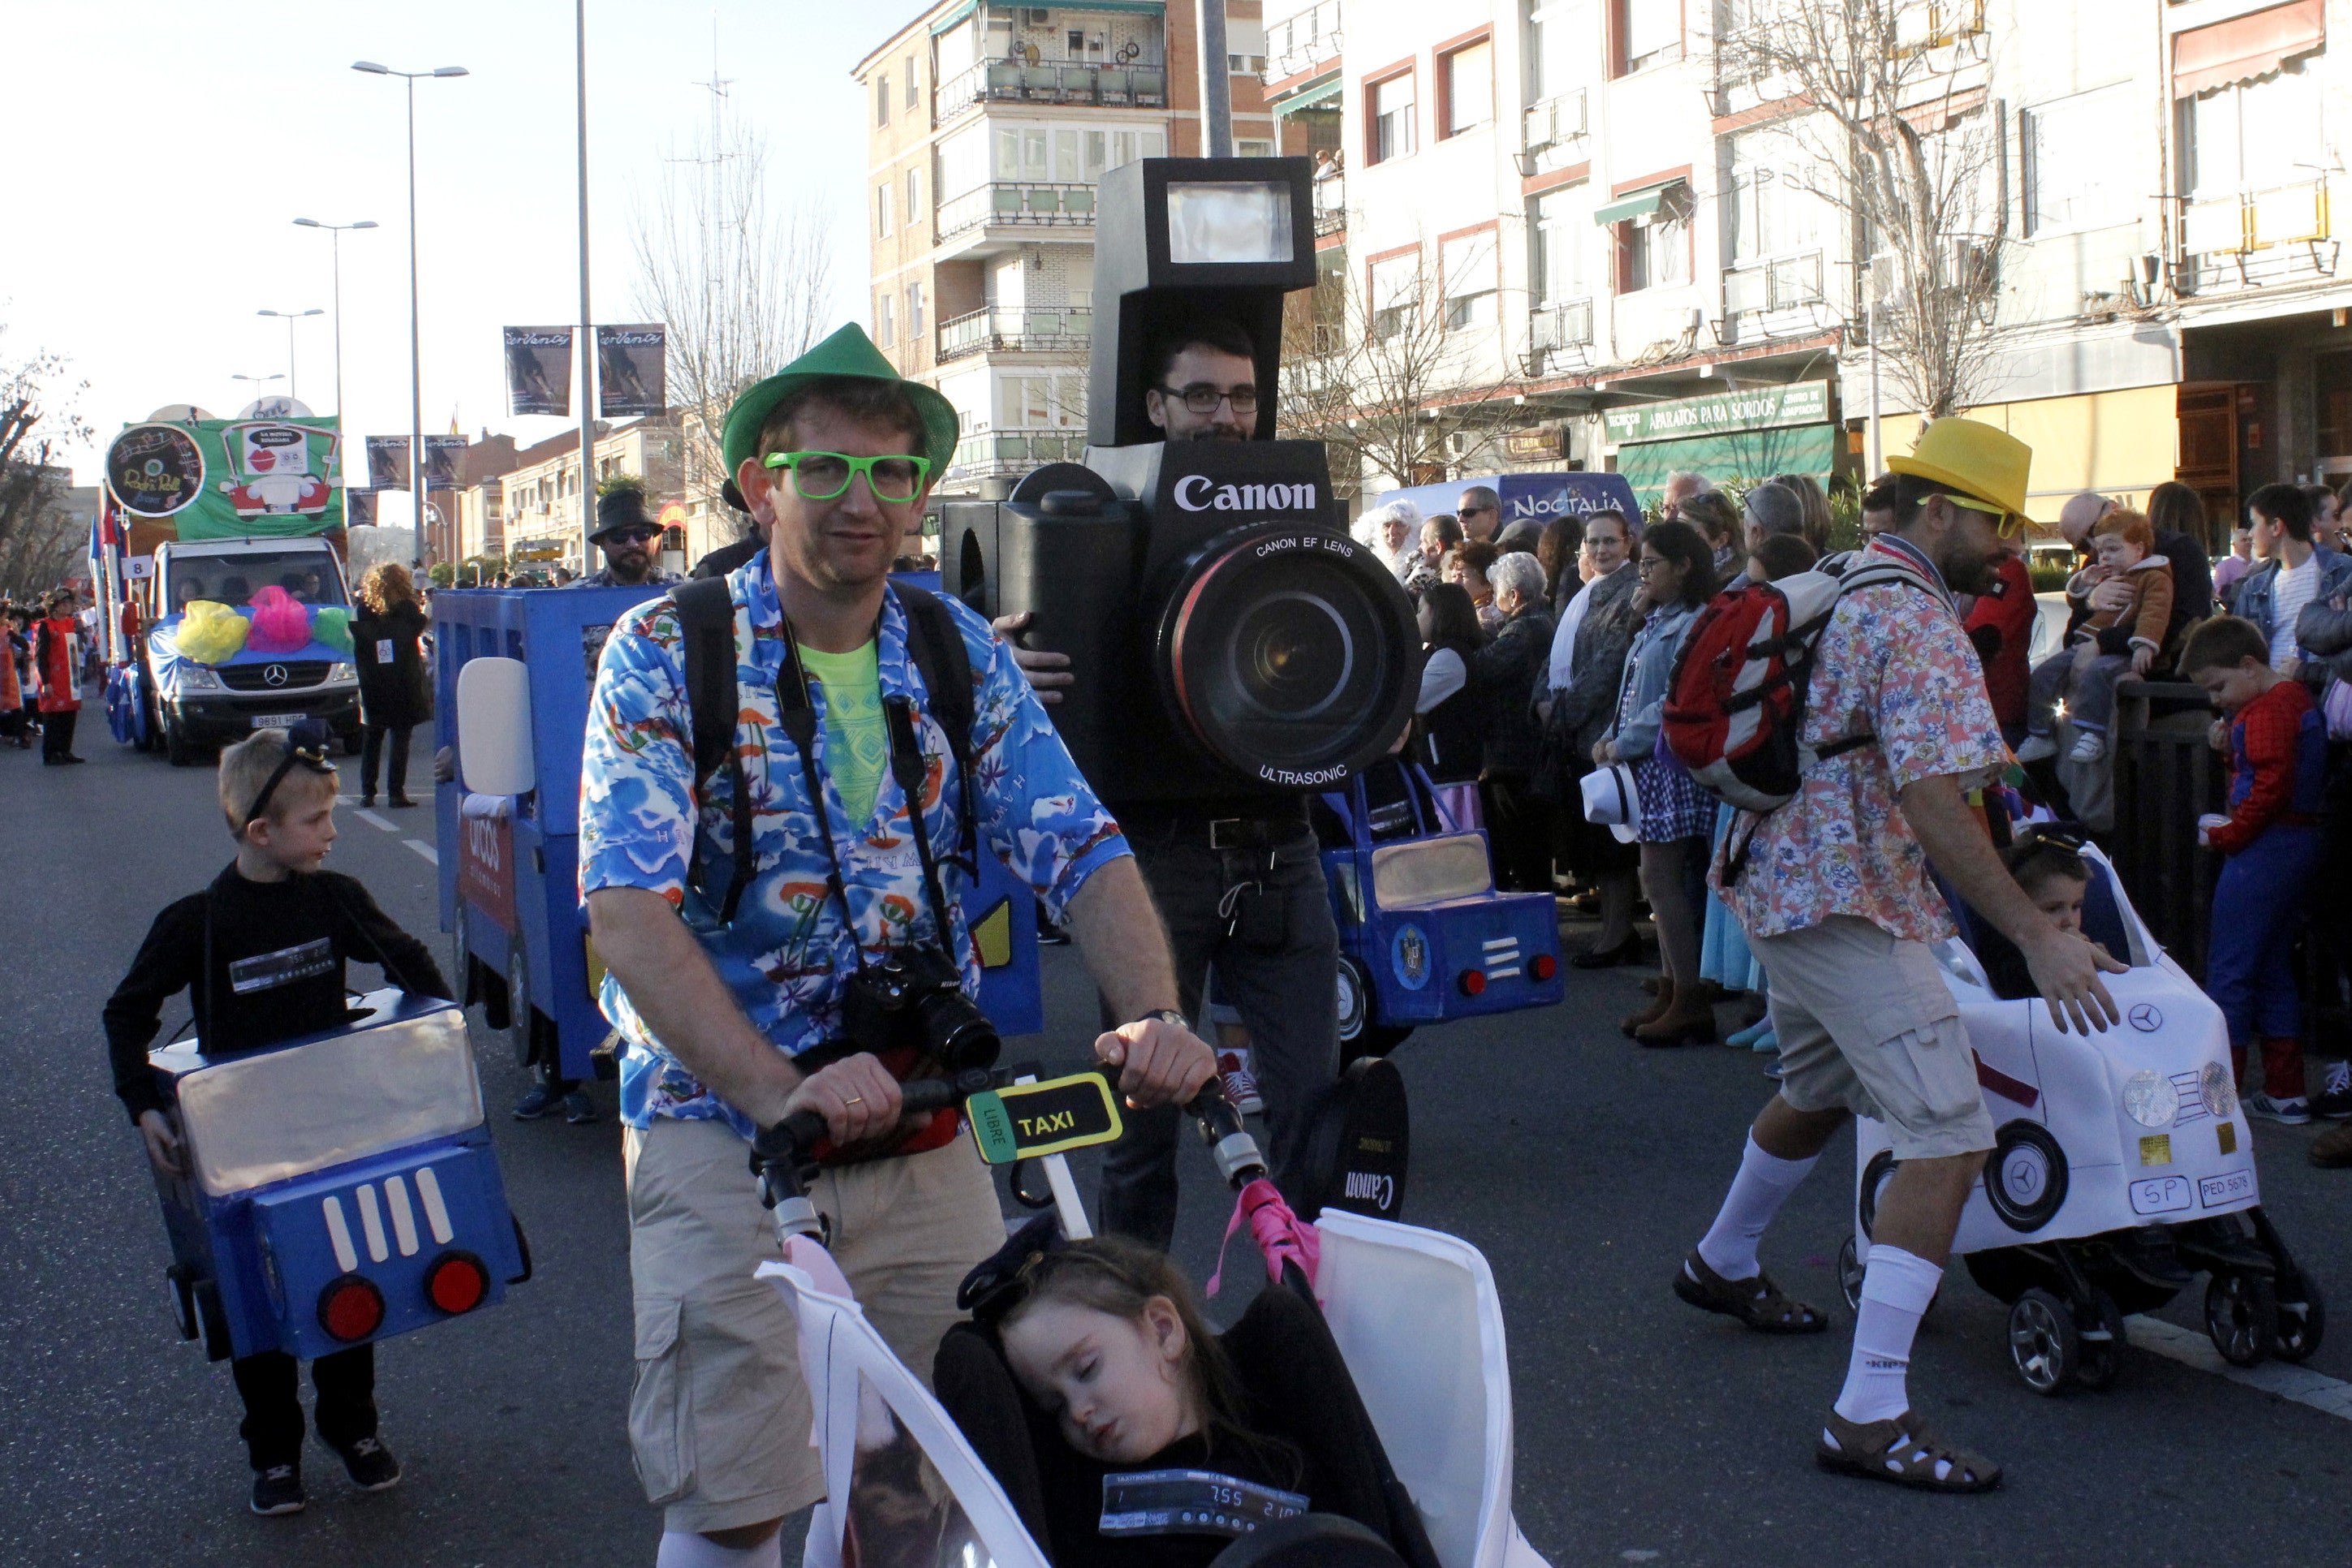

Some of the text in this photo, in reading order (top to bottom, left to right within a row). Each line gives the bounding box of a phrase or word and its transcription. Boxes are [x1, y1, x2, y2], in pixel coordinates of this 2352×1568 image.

[1649, 406, 1698, 431] APARATOS
[1700, 401, 1728, 423] PARA
[1732, 396, 1777, 421] SORDOS
[1174, 475, 1316, 512] Canon
[1256, 536, 1354, 558] CANON EF LENS
[134, 563, 142, 575] 8
[1260, 764, 1347, 786] ULTRASONIC
[982, 1108, 1006, 1146] LIBRE
[1018, 1109, 1075, 1137] TAXI
[1345, 1171, 1394, 1211] Canon
[2202, 1181, 2225, 1197] PED
